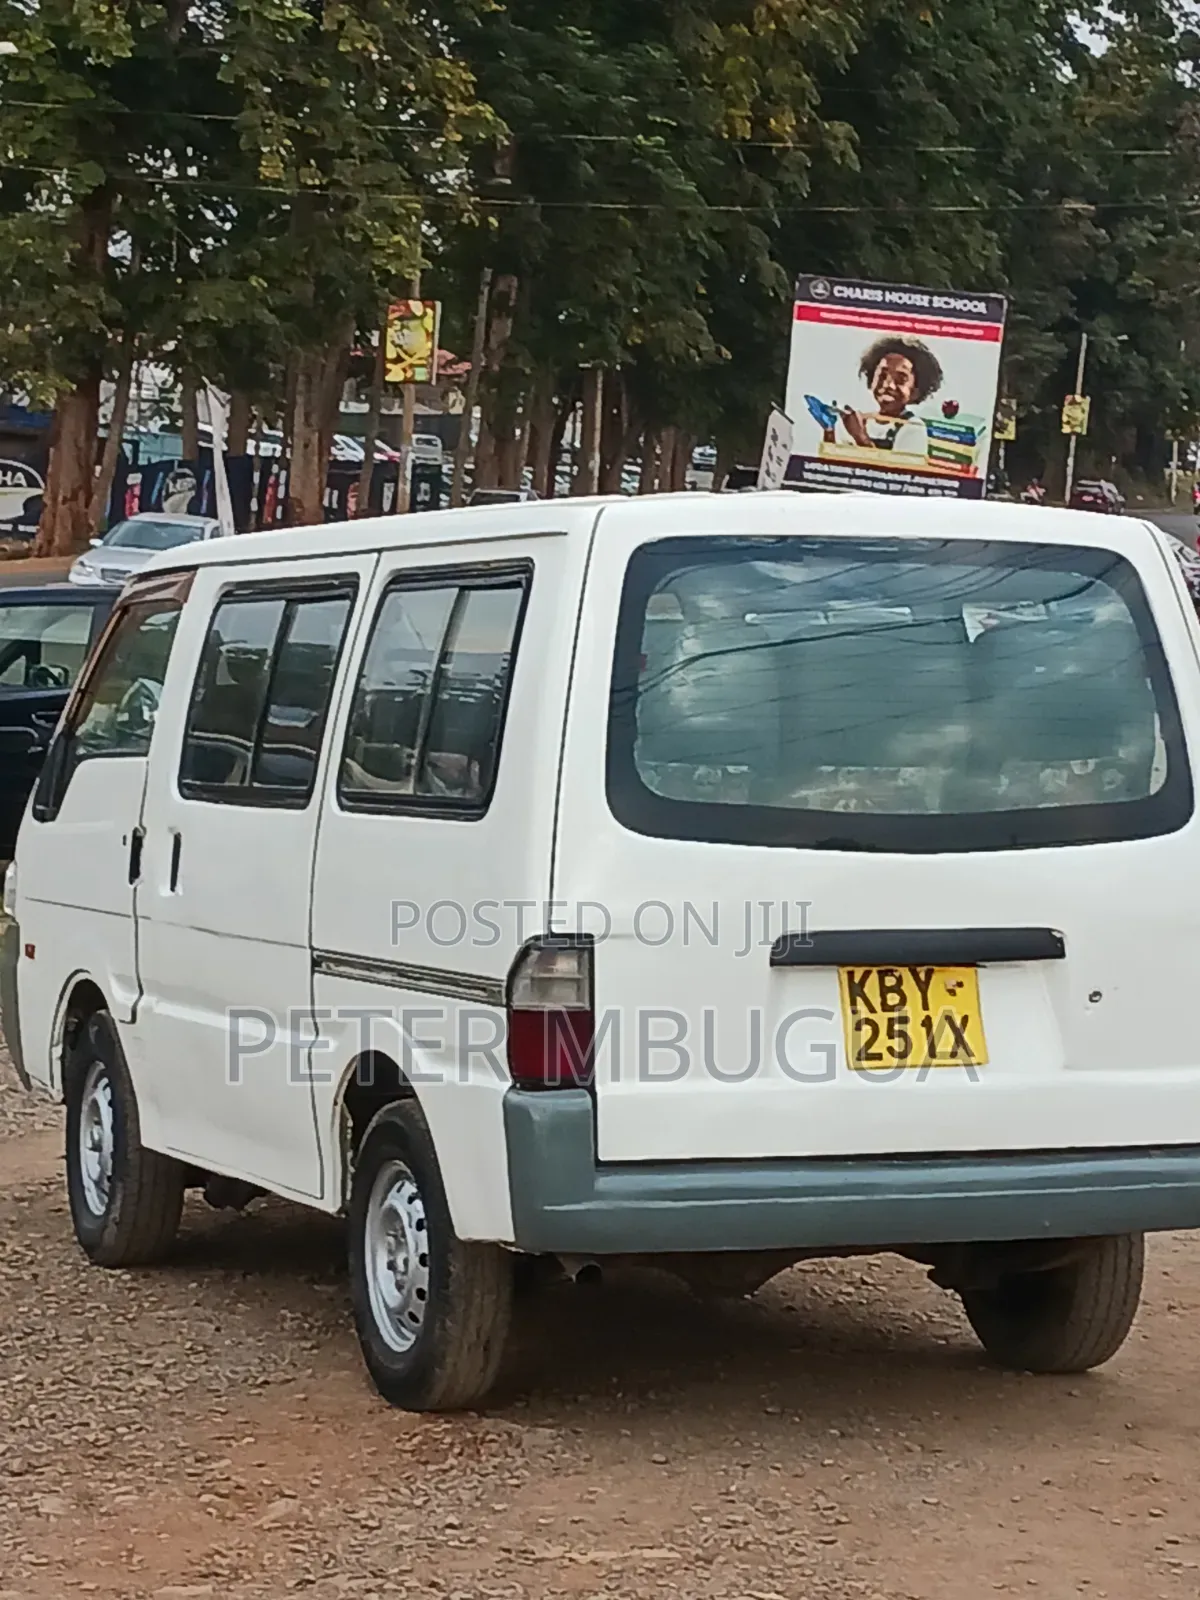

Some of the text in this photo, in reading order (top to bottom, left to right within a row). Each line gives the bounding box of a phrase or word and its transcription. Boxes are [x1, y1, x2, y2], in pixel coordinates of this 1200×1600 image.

[884, 290, 930, 307] HOUSE
[932, 295, 987, 314] SCHOOL
[846, 966, 935, 1015] KBY
[854, 1014, 976, 1061] 251X
